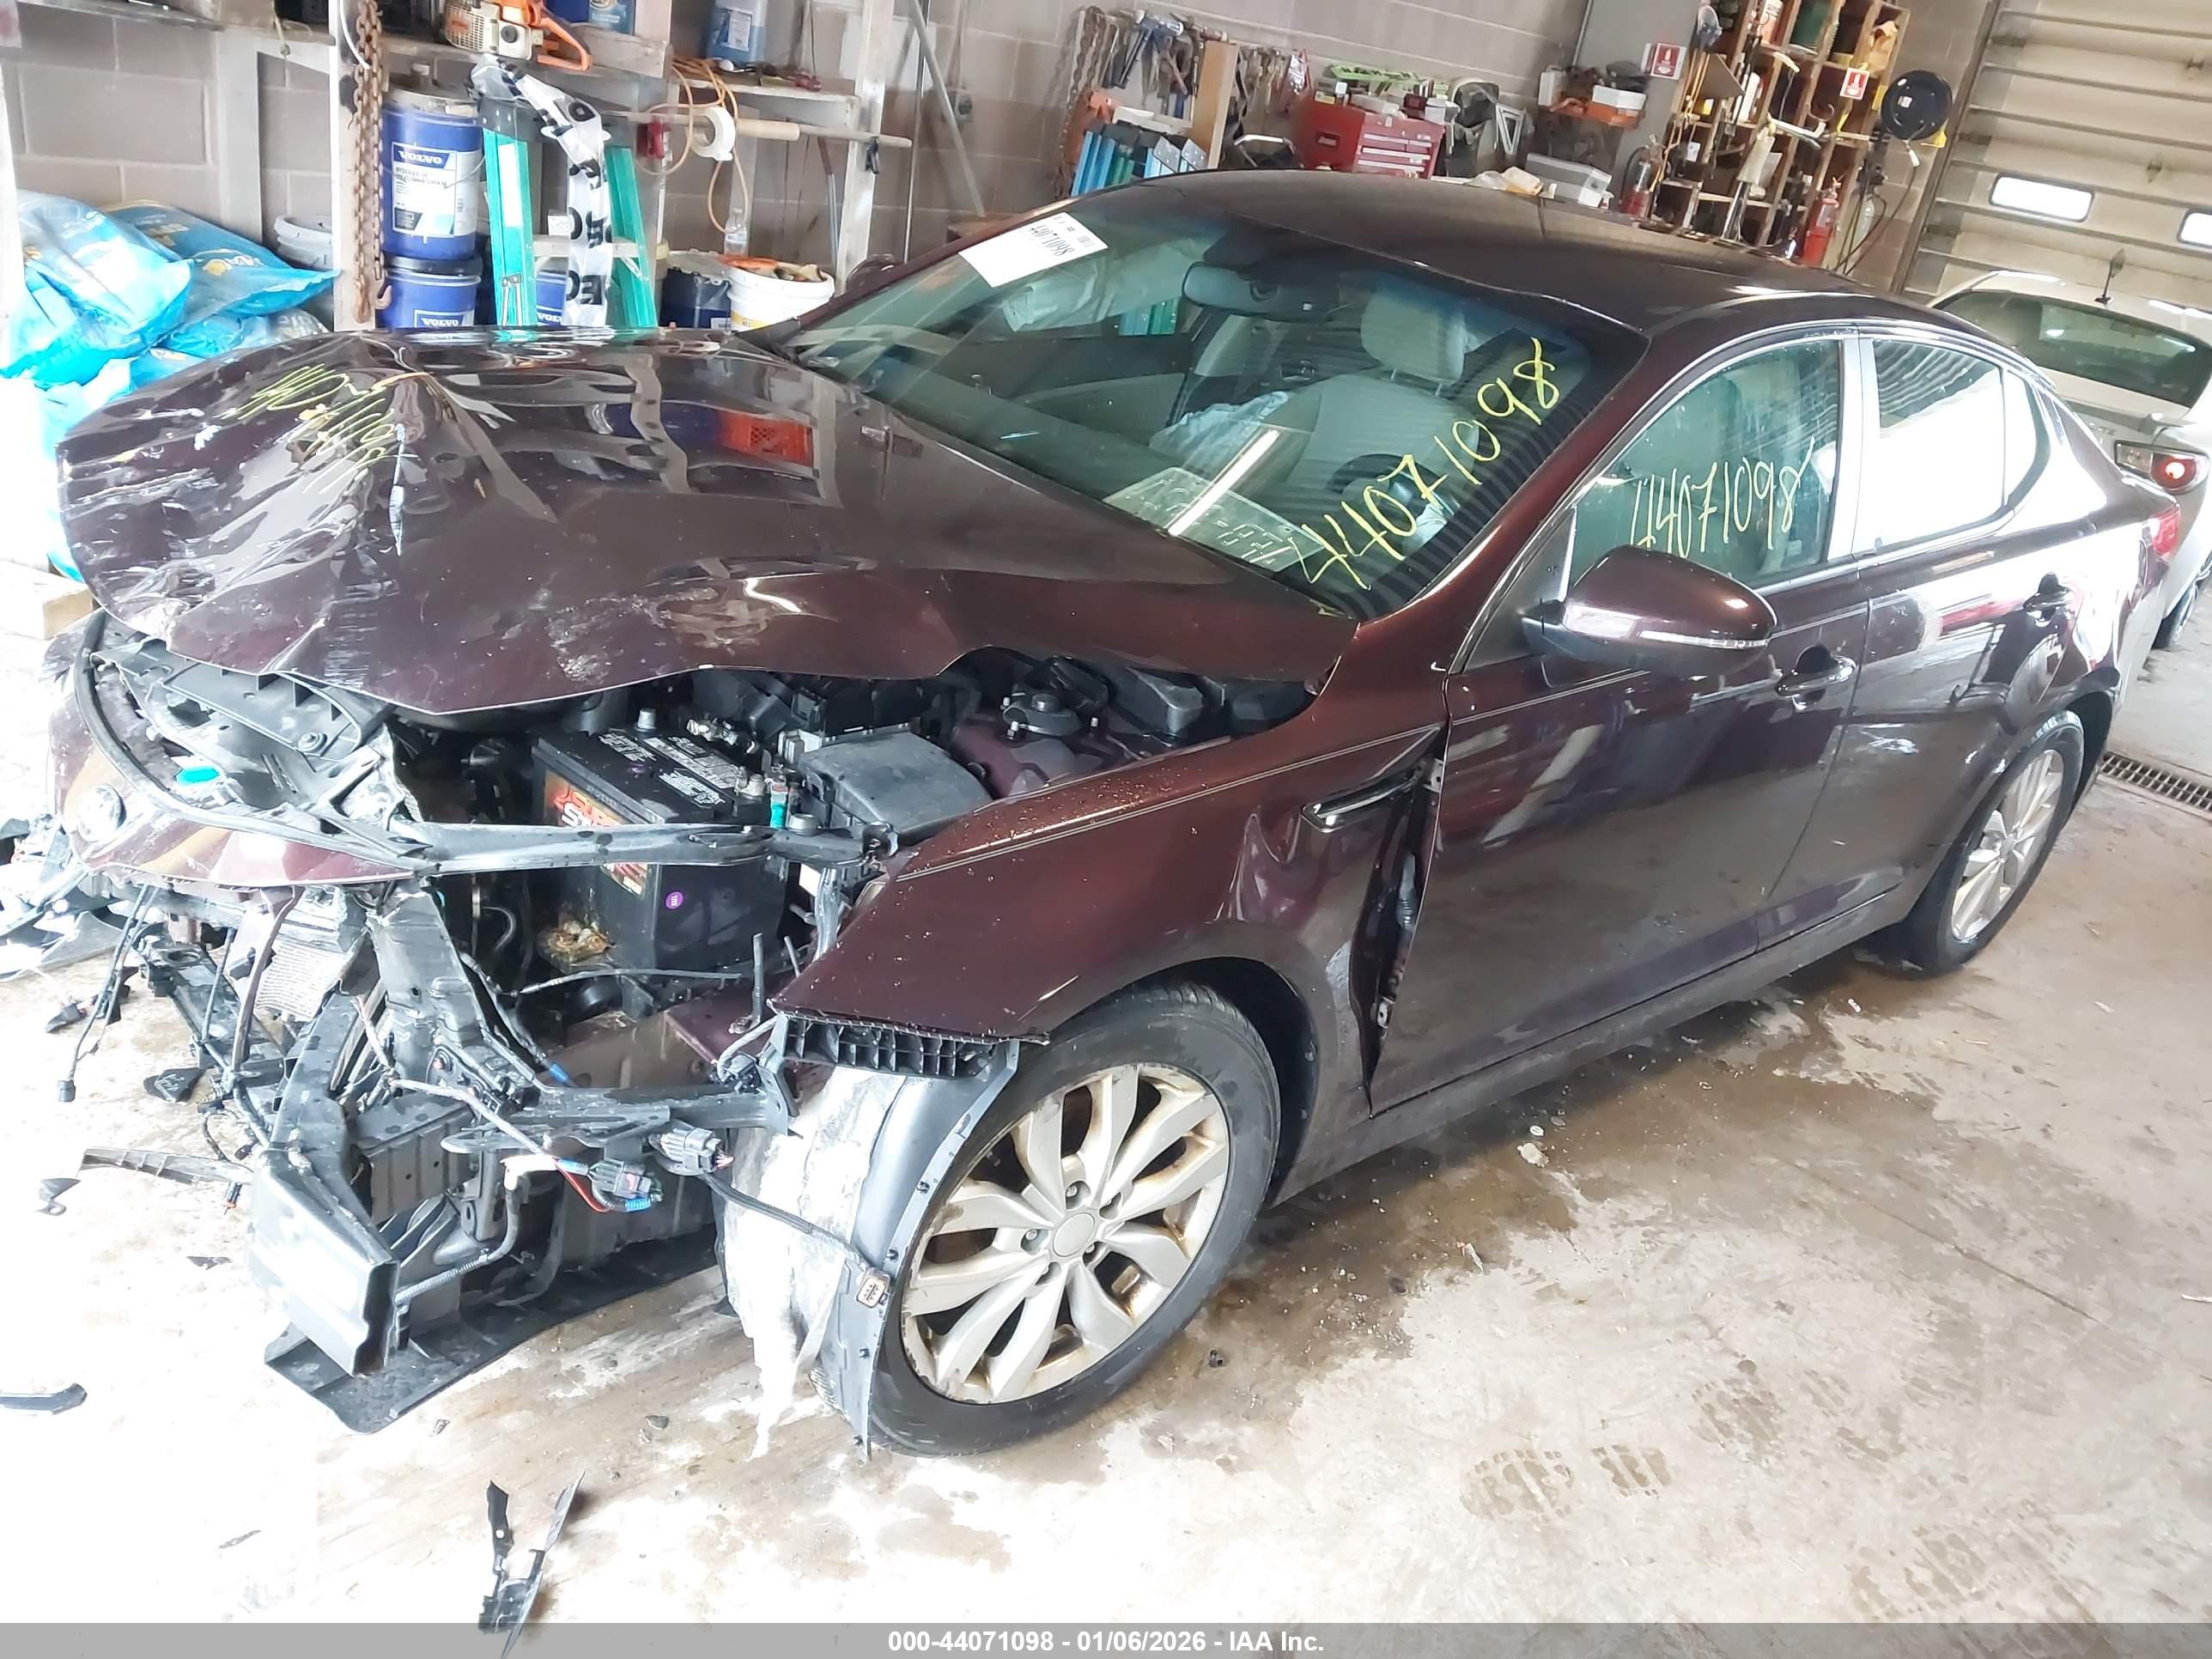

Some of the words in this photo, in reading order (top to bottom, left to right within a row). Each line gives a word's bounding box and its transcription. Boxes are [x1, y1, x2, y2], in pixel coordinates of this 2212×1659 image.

[398, 149, 443, 165] VOLVO
[421, 317, 459, 327] VOLVO
[1287, 337, 1559, 590] 44071098
[1631, 435, 1815, 559] 44071098
